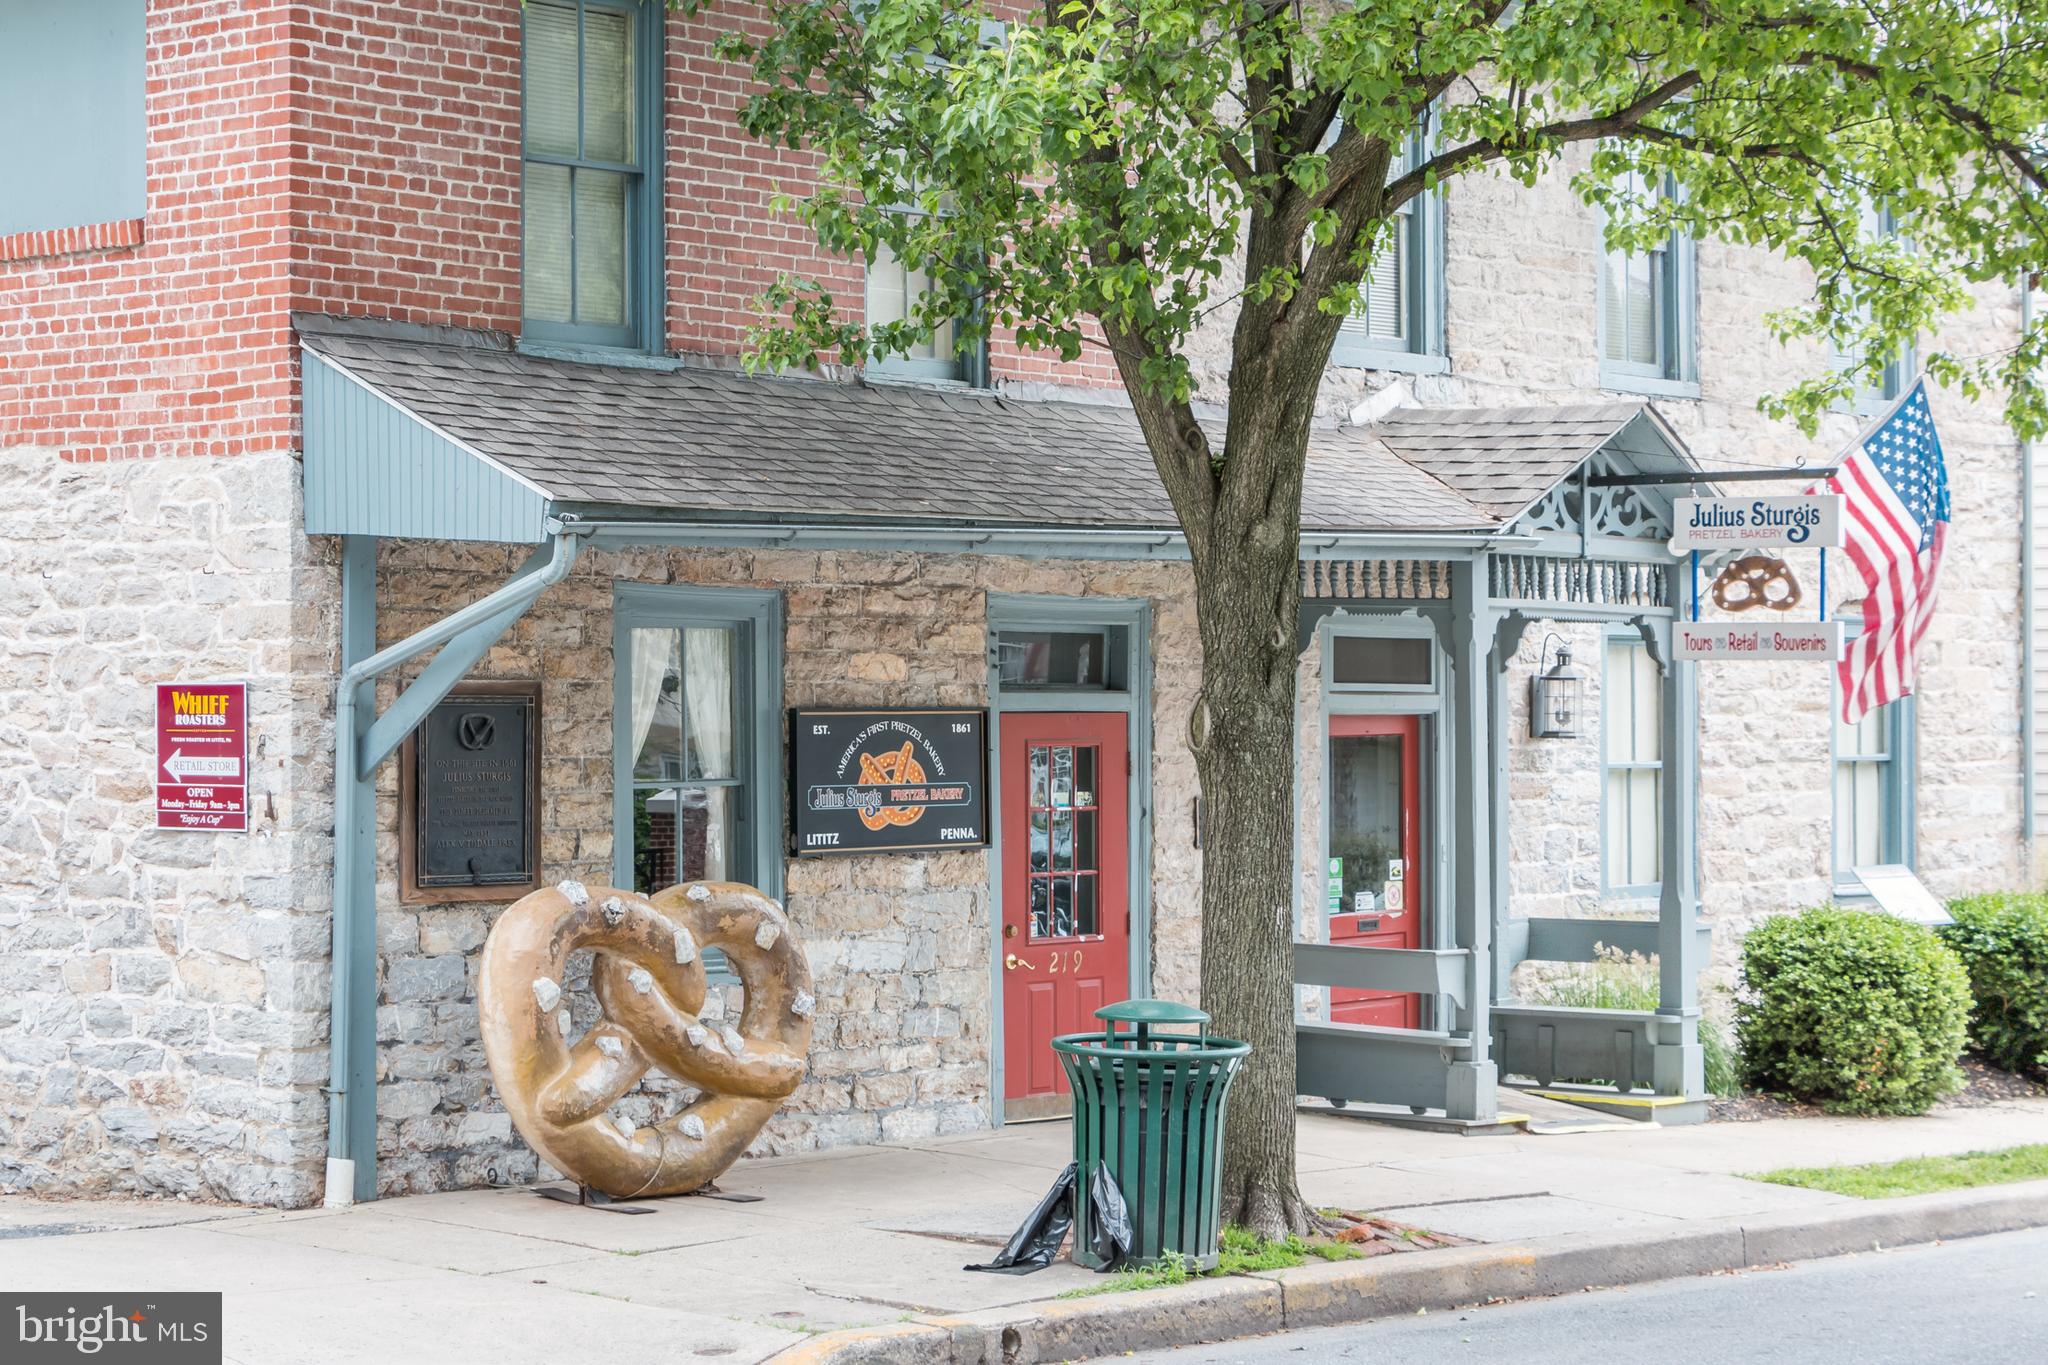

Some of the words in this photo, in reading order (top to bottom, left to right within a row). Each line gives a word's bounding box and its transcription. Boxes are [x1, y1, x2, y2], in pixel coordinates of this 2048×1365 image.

[1689, 503, 1745, 528] Julius
[1751, 501, 1821, 544] Sturgis
[1689, 529, 1736, 540] PRETZEL
[1740, 528, 1784, 539] BAKERY
[1684, 632, 1713, 651] Tours
[1728, 631, 1758, 651] Retail
[1774, 632, 1826, 651] Souvenirs
[172, 691, 229, 715] WHIFF
[175, 714, 226, 726] ROASTERS
[813, 724, 831, 735] EST.
[951, 723, 971, 733] 1861
[866, 721, 889, 736] FIRST
[891, 721, 923, 743] PRETZEL
[922, 739, 946, 776] BAKERY
[173, 760, 204, 771] RETAIL
[208, 761, 237, 772] STORE
[442, 771, 473, 782] JULIUS
[477, 771, 512, 782] STURGIS
[187, 788, 214, 798] OPEN
[814, 788, 844, 808] Julius
[846, 787, 882, 817] Sturgis
[890, 788, 929, 801] PRETZEL
[930, 787, 964, 800] BAKERY
[807, 833, 840, 846] LITITZ
[940, 828, 978, 840] PENNA.
[1049, 950, 1083, 974] 219
